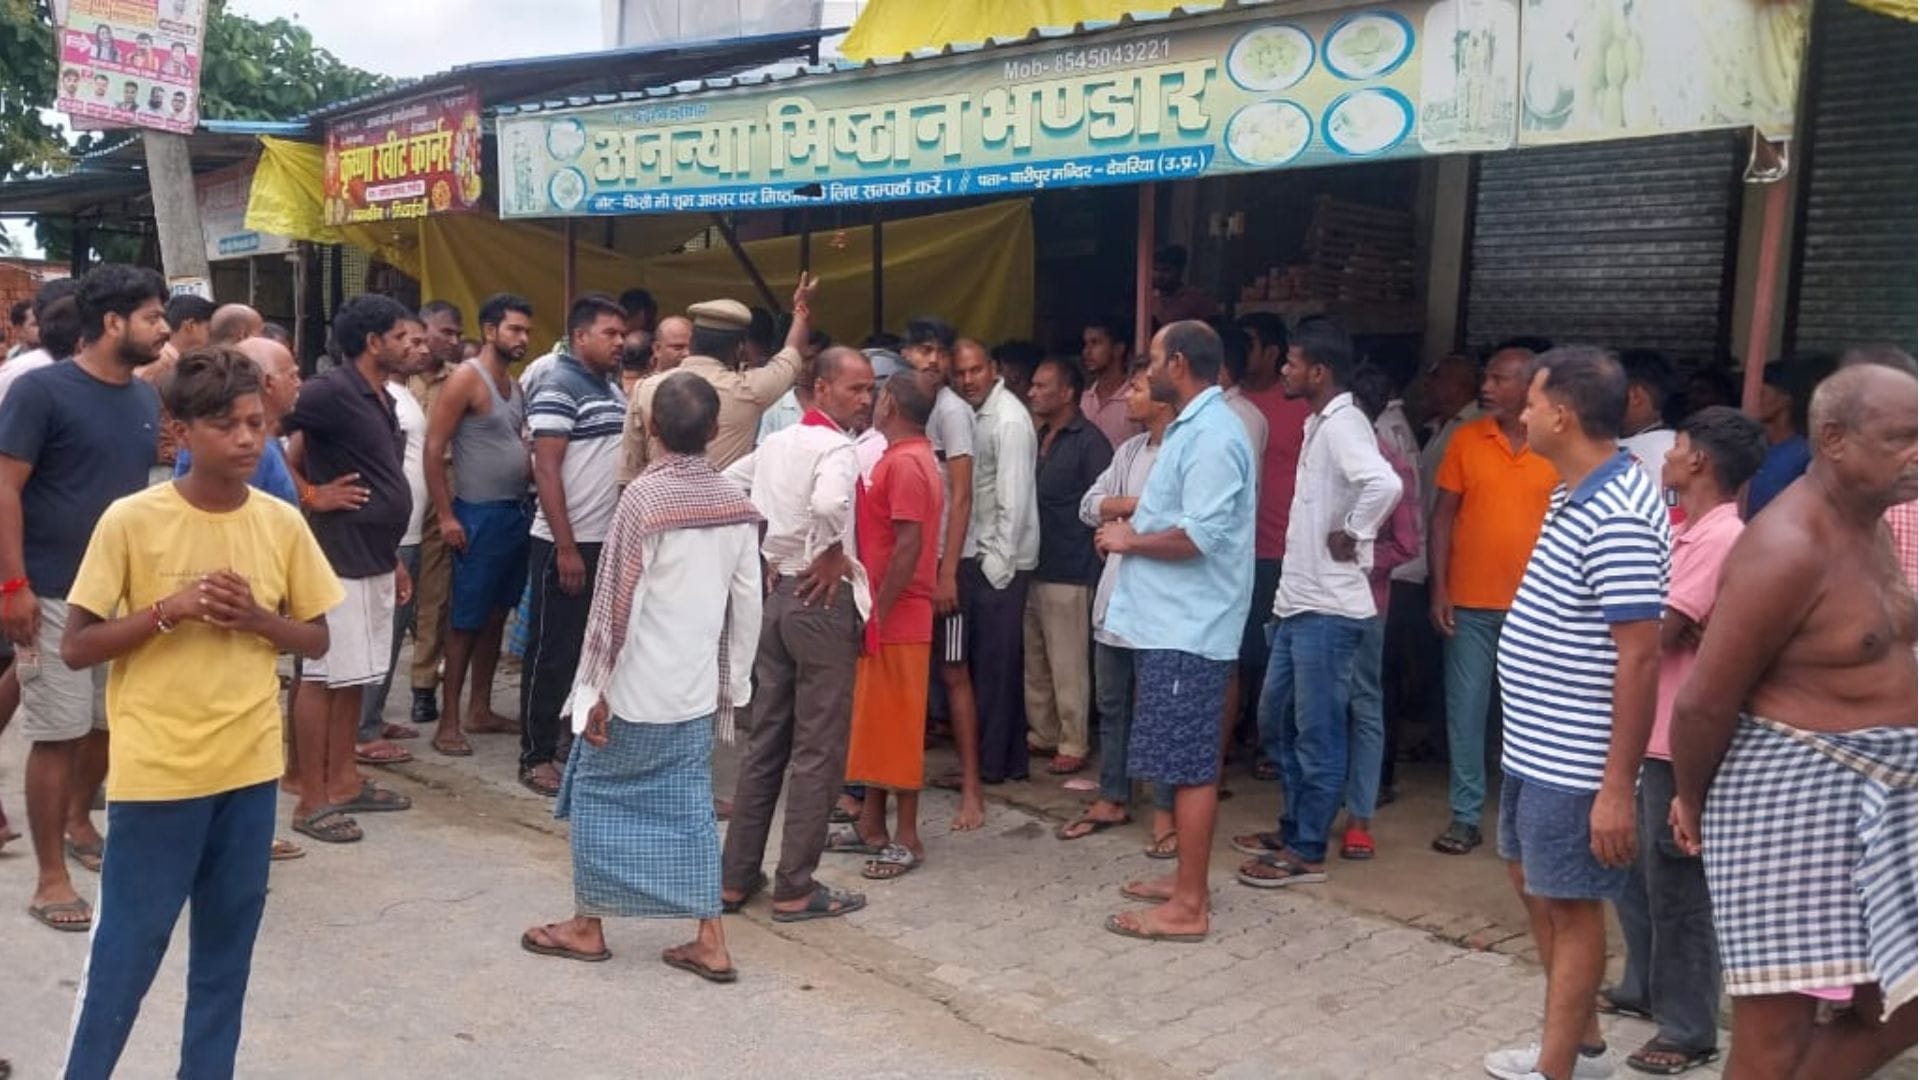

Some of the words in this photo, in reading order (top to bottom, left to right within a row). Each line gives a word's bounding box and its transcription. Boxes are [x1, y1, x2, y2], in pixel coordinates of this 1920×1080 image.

[1003, 60, 1050, 81] Mob-
[1054, 38, 1170, 73] 8545043221
[593, 117, 756, 185] अनन्या
[767, 94, 972, 177] मिष्ठान
[980, 60, 1216, 153] भण्डार
[738, 191, 758, 205] पर
[831, 182, 859, 201] लिए
[863, 180, 911, 199] सम्पर्क
